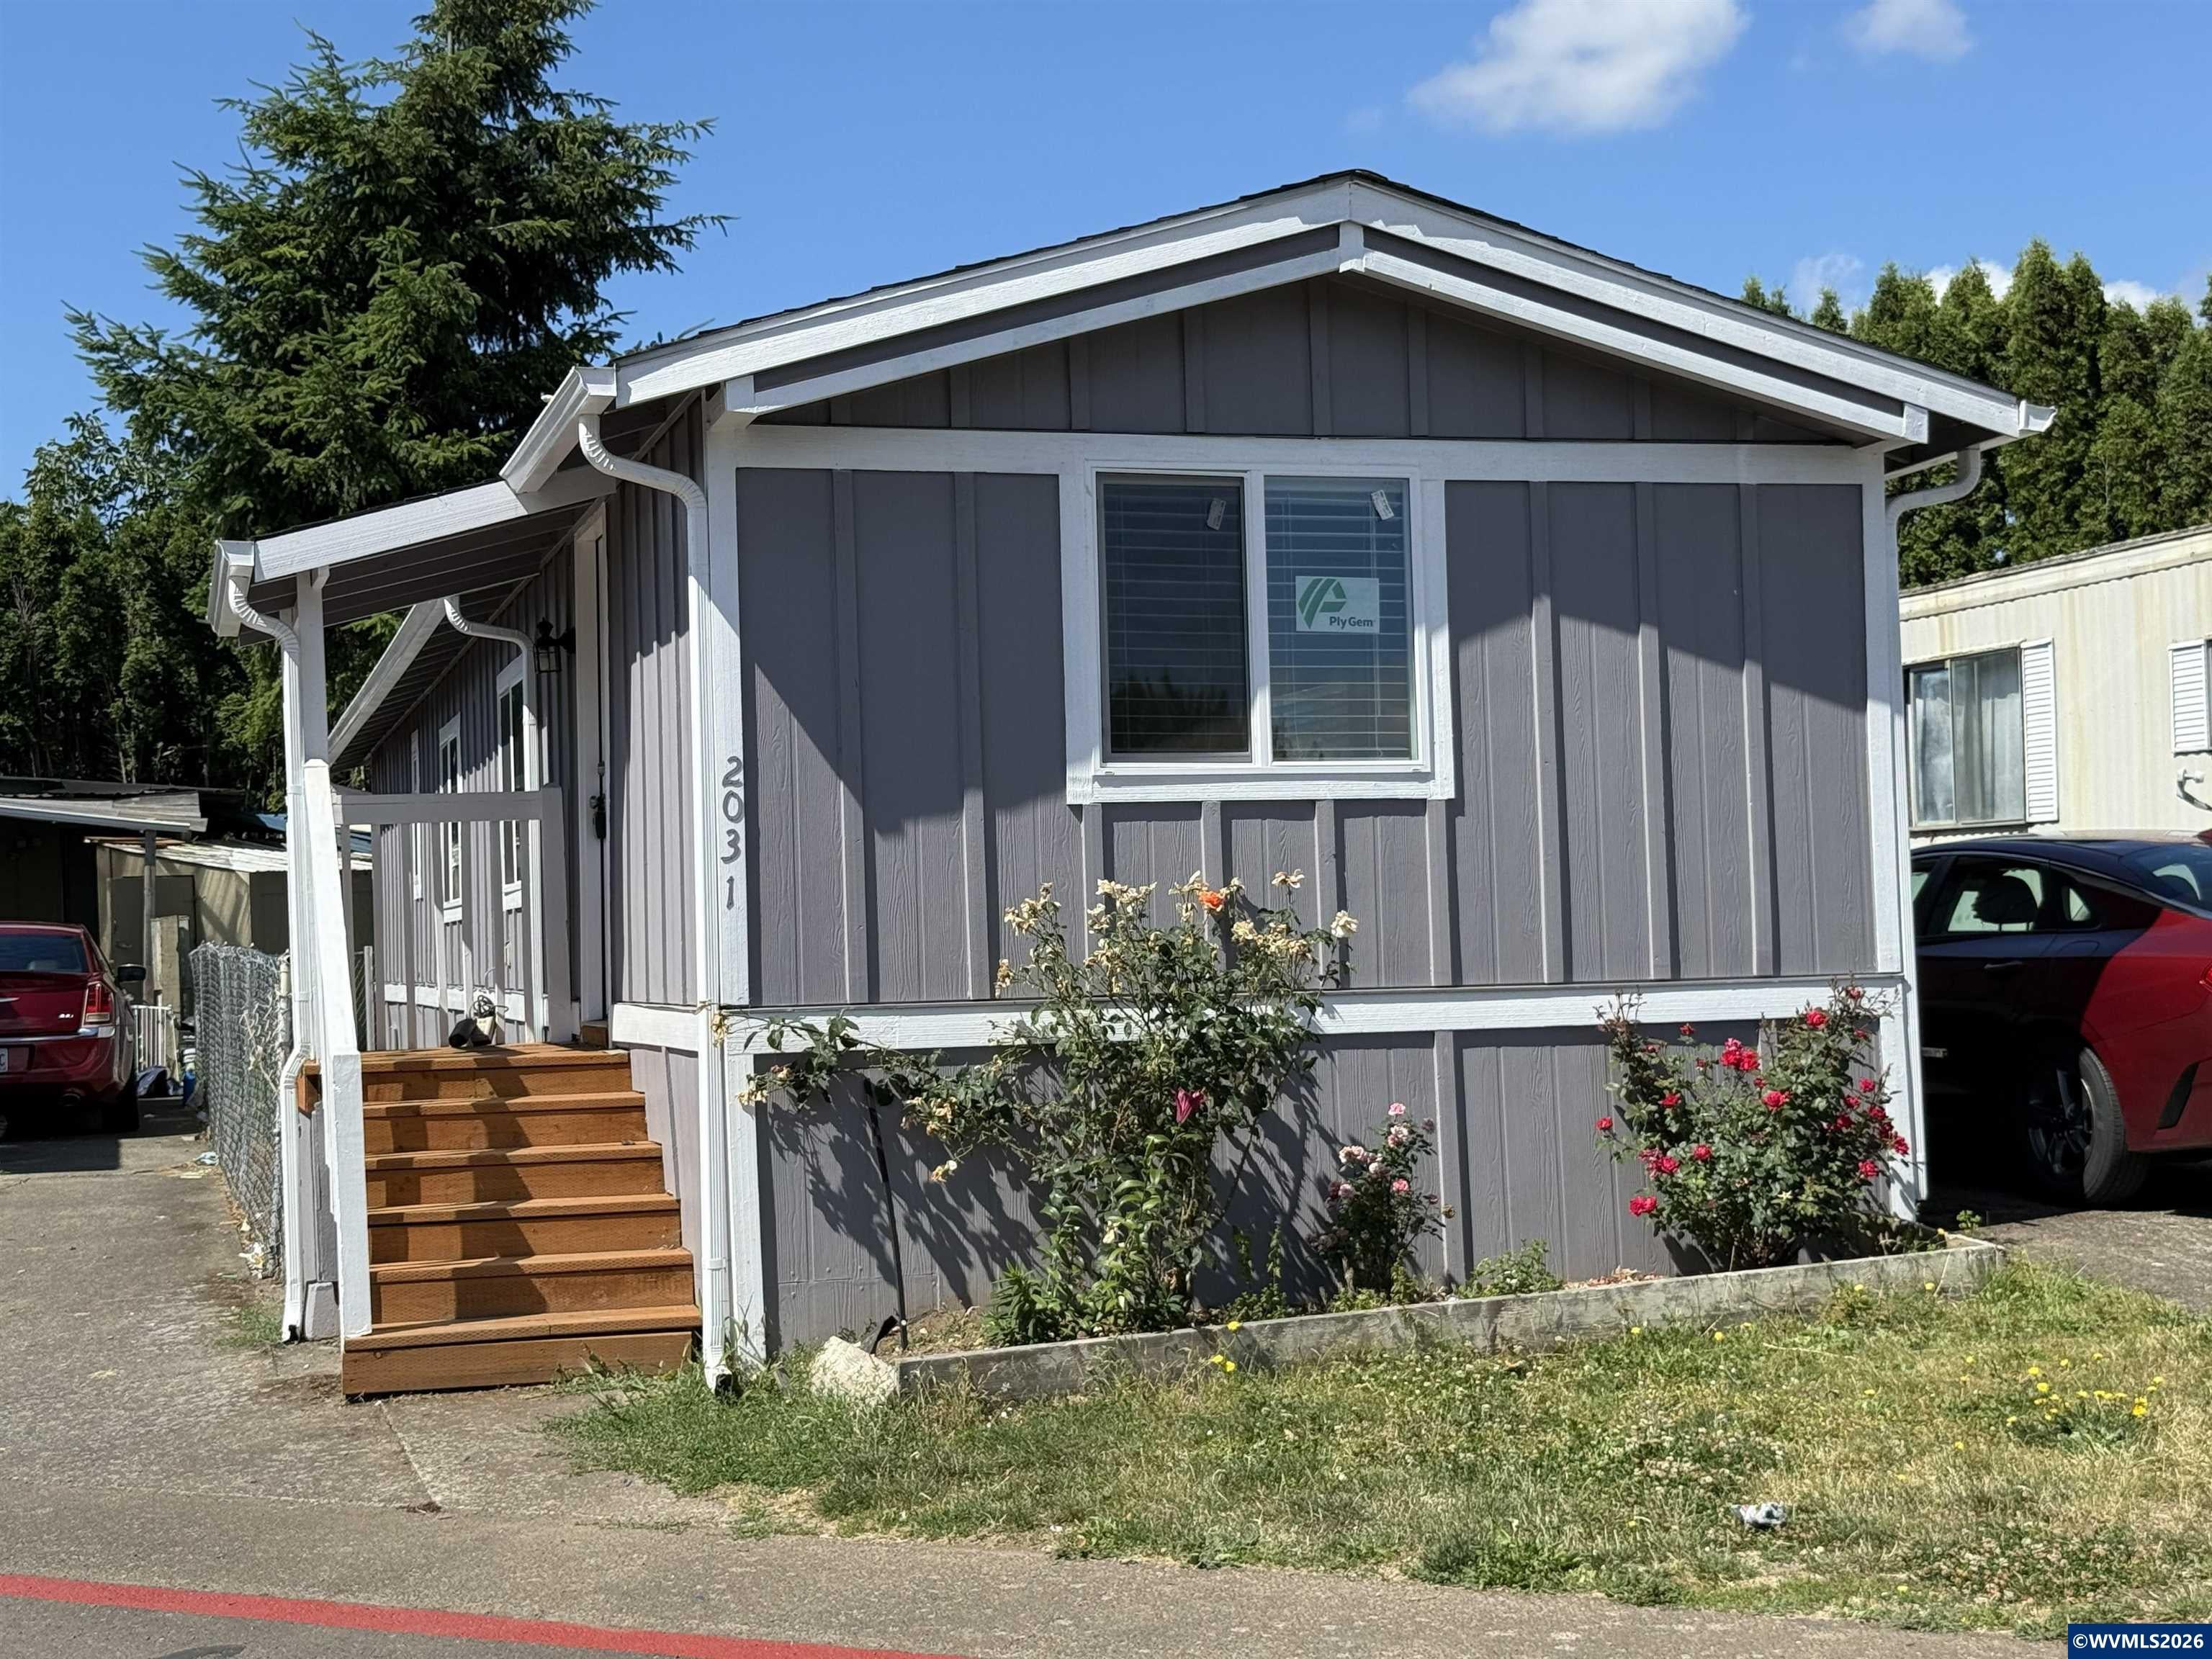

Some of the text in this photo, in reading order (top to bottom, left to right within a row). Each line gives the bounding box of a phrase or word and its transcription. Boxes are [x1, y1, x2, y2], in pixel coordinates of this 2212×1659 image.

[1329, 616, 1373, 629] Ply Gem
[721, 756, 745, 910] 2031
